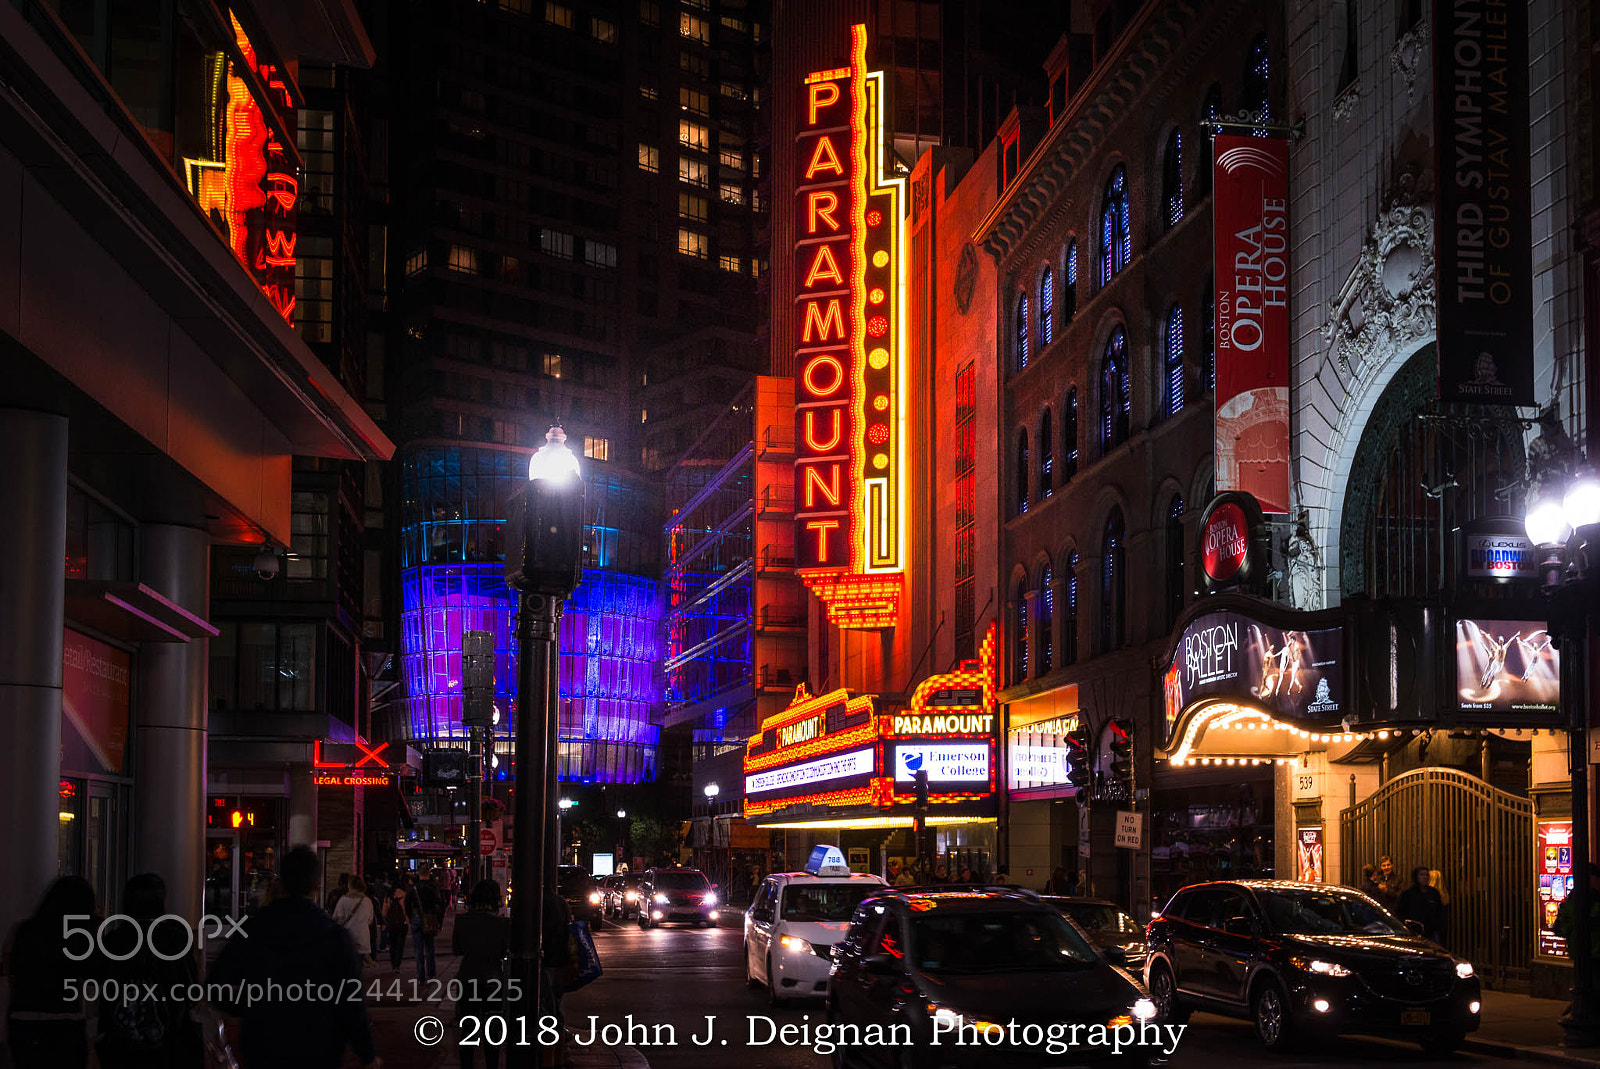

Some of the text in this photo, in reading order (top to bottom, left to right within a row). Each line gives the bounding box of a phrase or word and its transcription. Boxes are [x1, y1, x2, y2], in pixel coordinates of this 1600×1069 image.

[1487, 128, 1511, 249] GUSTAV
[1264, 198, 1287, 308] HOUSE
[1457, 202, 1485, 304] THIRD
[1231, 222, 1263, 352] OPERA
[1488, 264, 1512, 305] OF
[804, 81, 844, 562] PARAMOUNT
[1219, 290, 1231, 349] BOSTON
[1458, 384, 1512, 395] STATE STREET
[1208, 524, 1239, 550] OPERA
[1209, 520, 1228, 534] BOSTON
[1219, 538, 1246, 561] HOUSE
[1470, 549, 1535, 563] BROADWAY
[1487, 561, 1535, 570] BOSTON
[1185, 622, 1238, 664] BOSTON
[64, 645, 128, 686] etail/Restaurant
[1187, 642, 1235, 689] BALLET
[1307, 703, 1339, 714] STATE STREET
[781, 716, 819, 747] PARAMOUNT
[894, 714, 994, 734] PARAMOUNT
[929, 751, 985, 762] Emerson
[314, 777, 389, 785] LEGAL CROSSING
[941, 765, 985, 776] College
[1299, 776, 1313, 790] 539
[1117, 834, 1139, 844] ON RED
[1121, 825, 1137, 833] TURN
